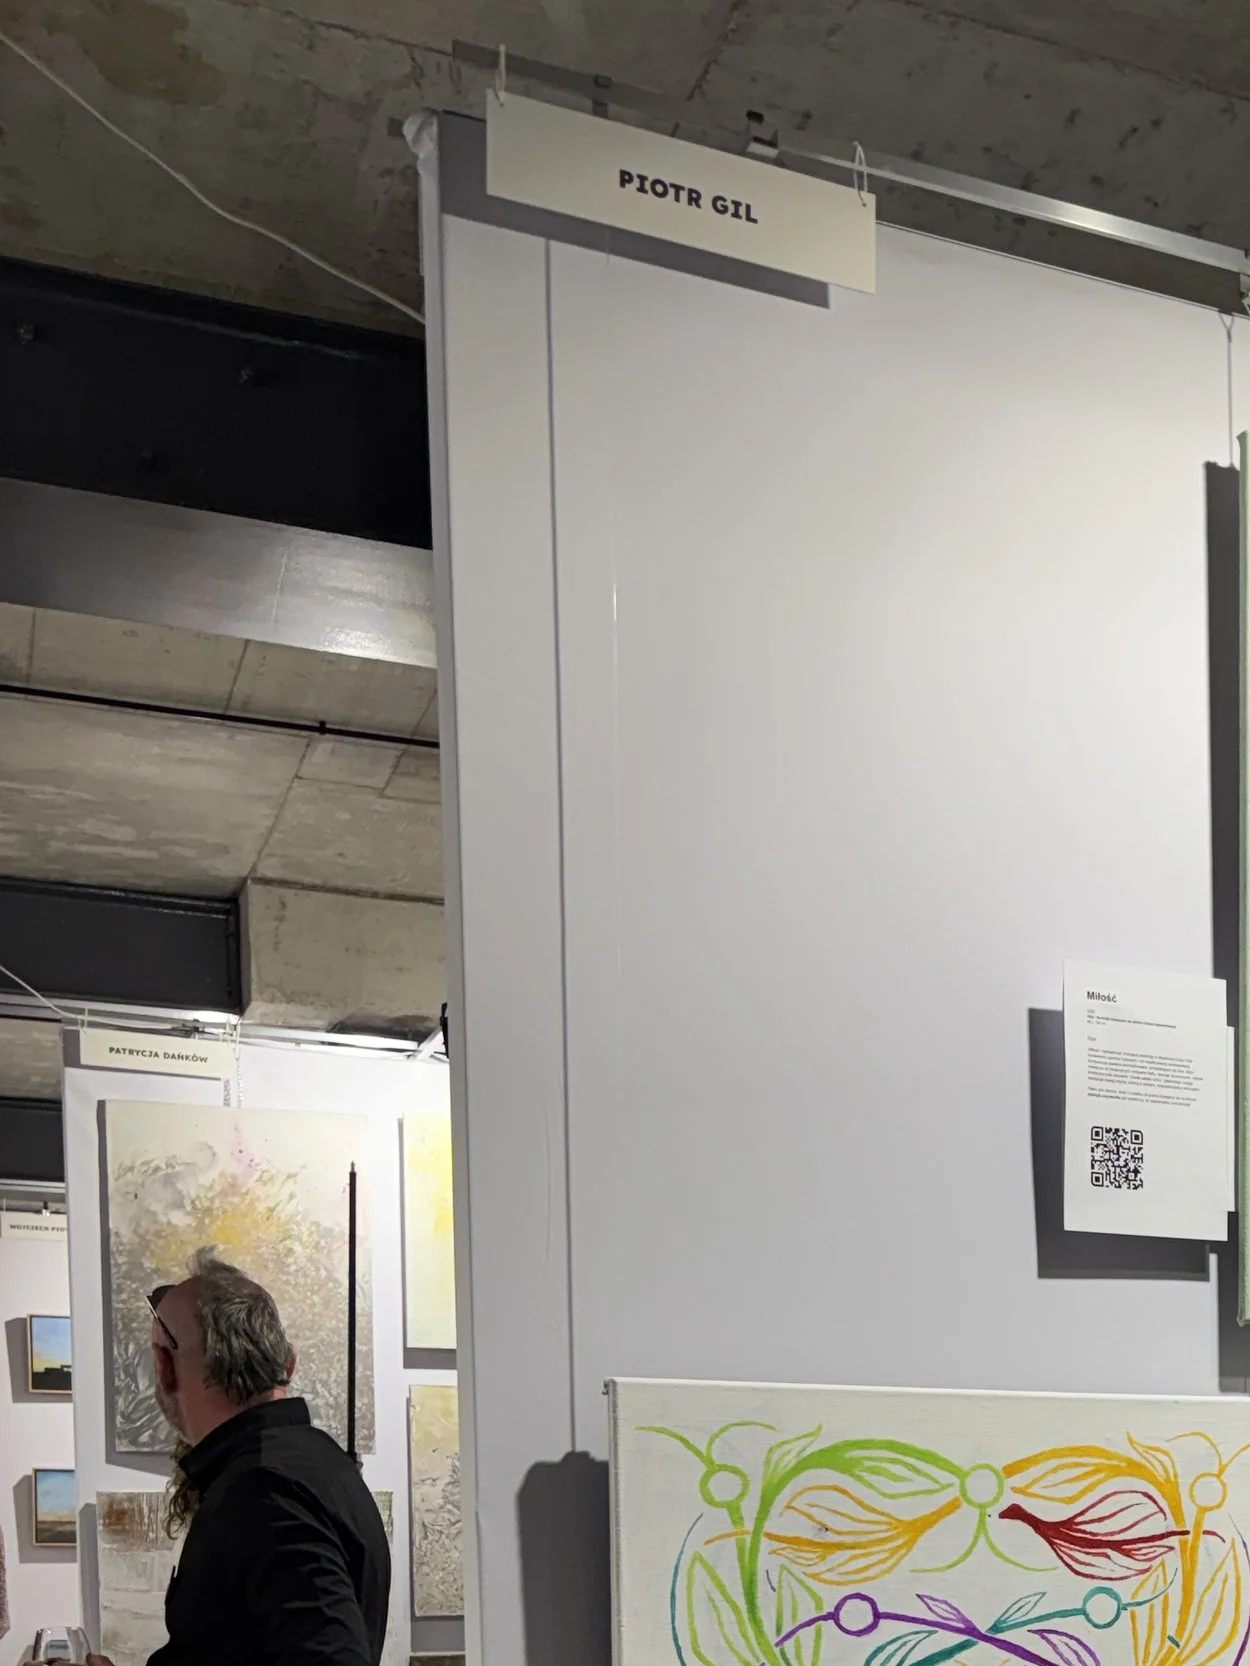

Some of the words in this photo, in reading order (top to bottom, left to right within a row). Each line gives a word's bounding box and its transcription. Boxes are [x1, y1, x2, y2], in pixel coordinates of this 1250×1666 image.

[619, 169, 702, 209] PIOTR
[711, 195, 758, 224] GIL
[1086, 990, 1118, 1003] Miłość
[109, 1046, 160, 1059] PATRYCJA
[163, 1051, 209, 1063] DAŃKÓW
